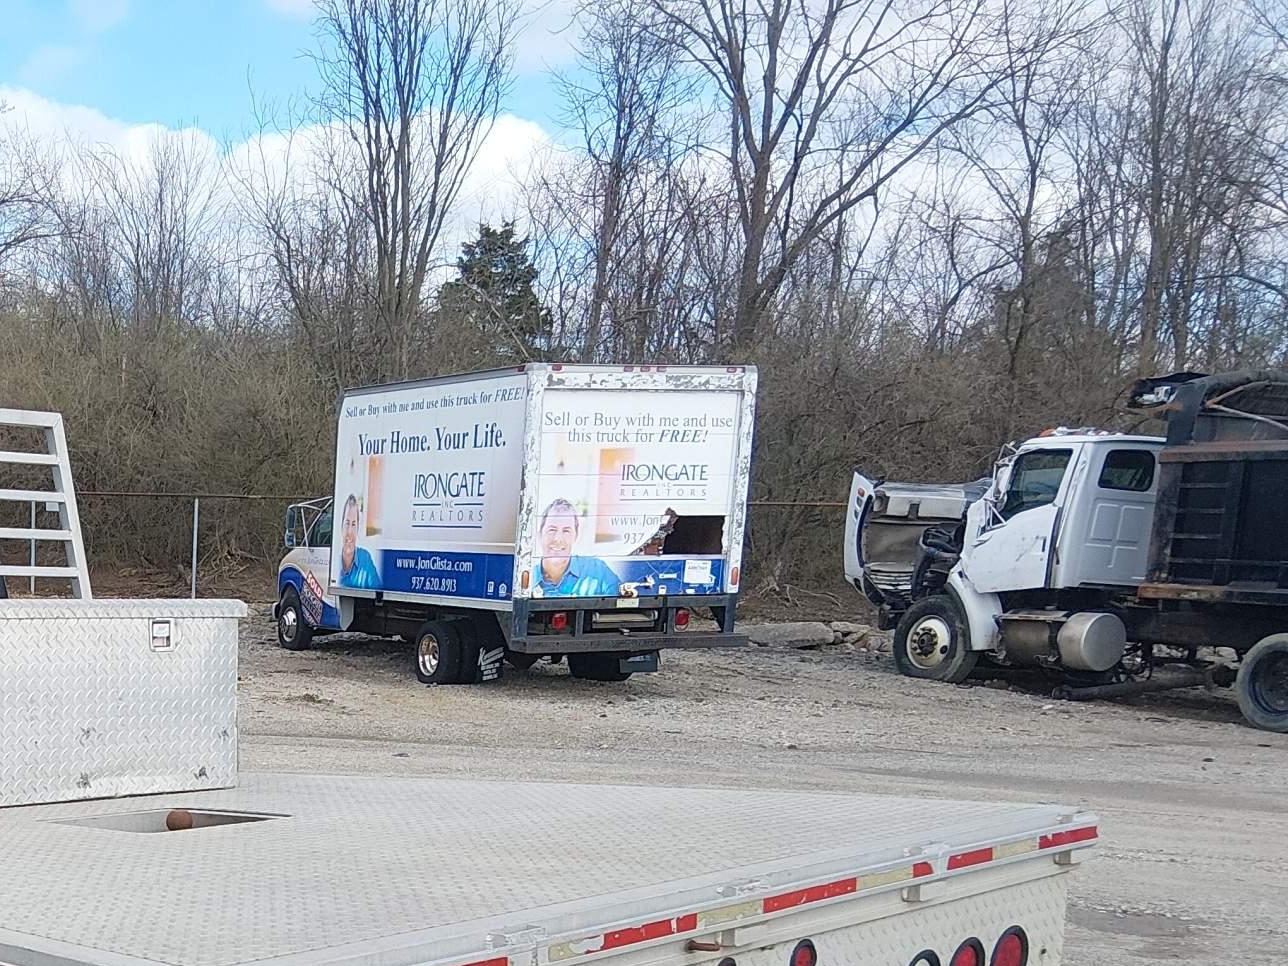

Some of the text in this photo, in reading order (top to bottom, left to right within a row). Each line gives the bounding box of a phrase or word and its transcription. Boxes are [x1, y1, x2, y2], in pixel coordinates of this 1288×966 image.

[346, 387, 525, 419] Sell or Buy with me and use this truck for FREE!
[544, 411, 733, 430] Sell or Buy with me and use
[358, 422, 506, 456] Your Home. Your Life.
[568, 428, 709, 443] this truck for FREE!
[621, 464, 709, 481] IRONGATE
[413, 471, 486, 500] IRONGATE
[619, 488, 707, 497] REALTORS
[441, 500, 454, 509] INC
[412, 510, 483, 522] REALTORS
[396, 556, 473, 572] www.JonGlista.com
[306, 573, 323, 599] SOLD
[411, 576, 457, 592] 937.620.8913
